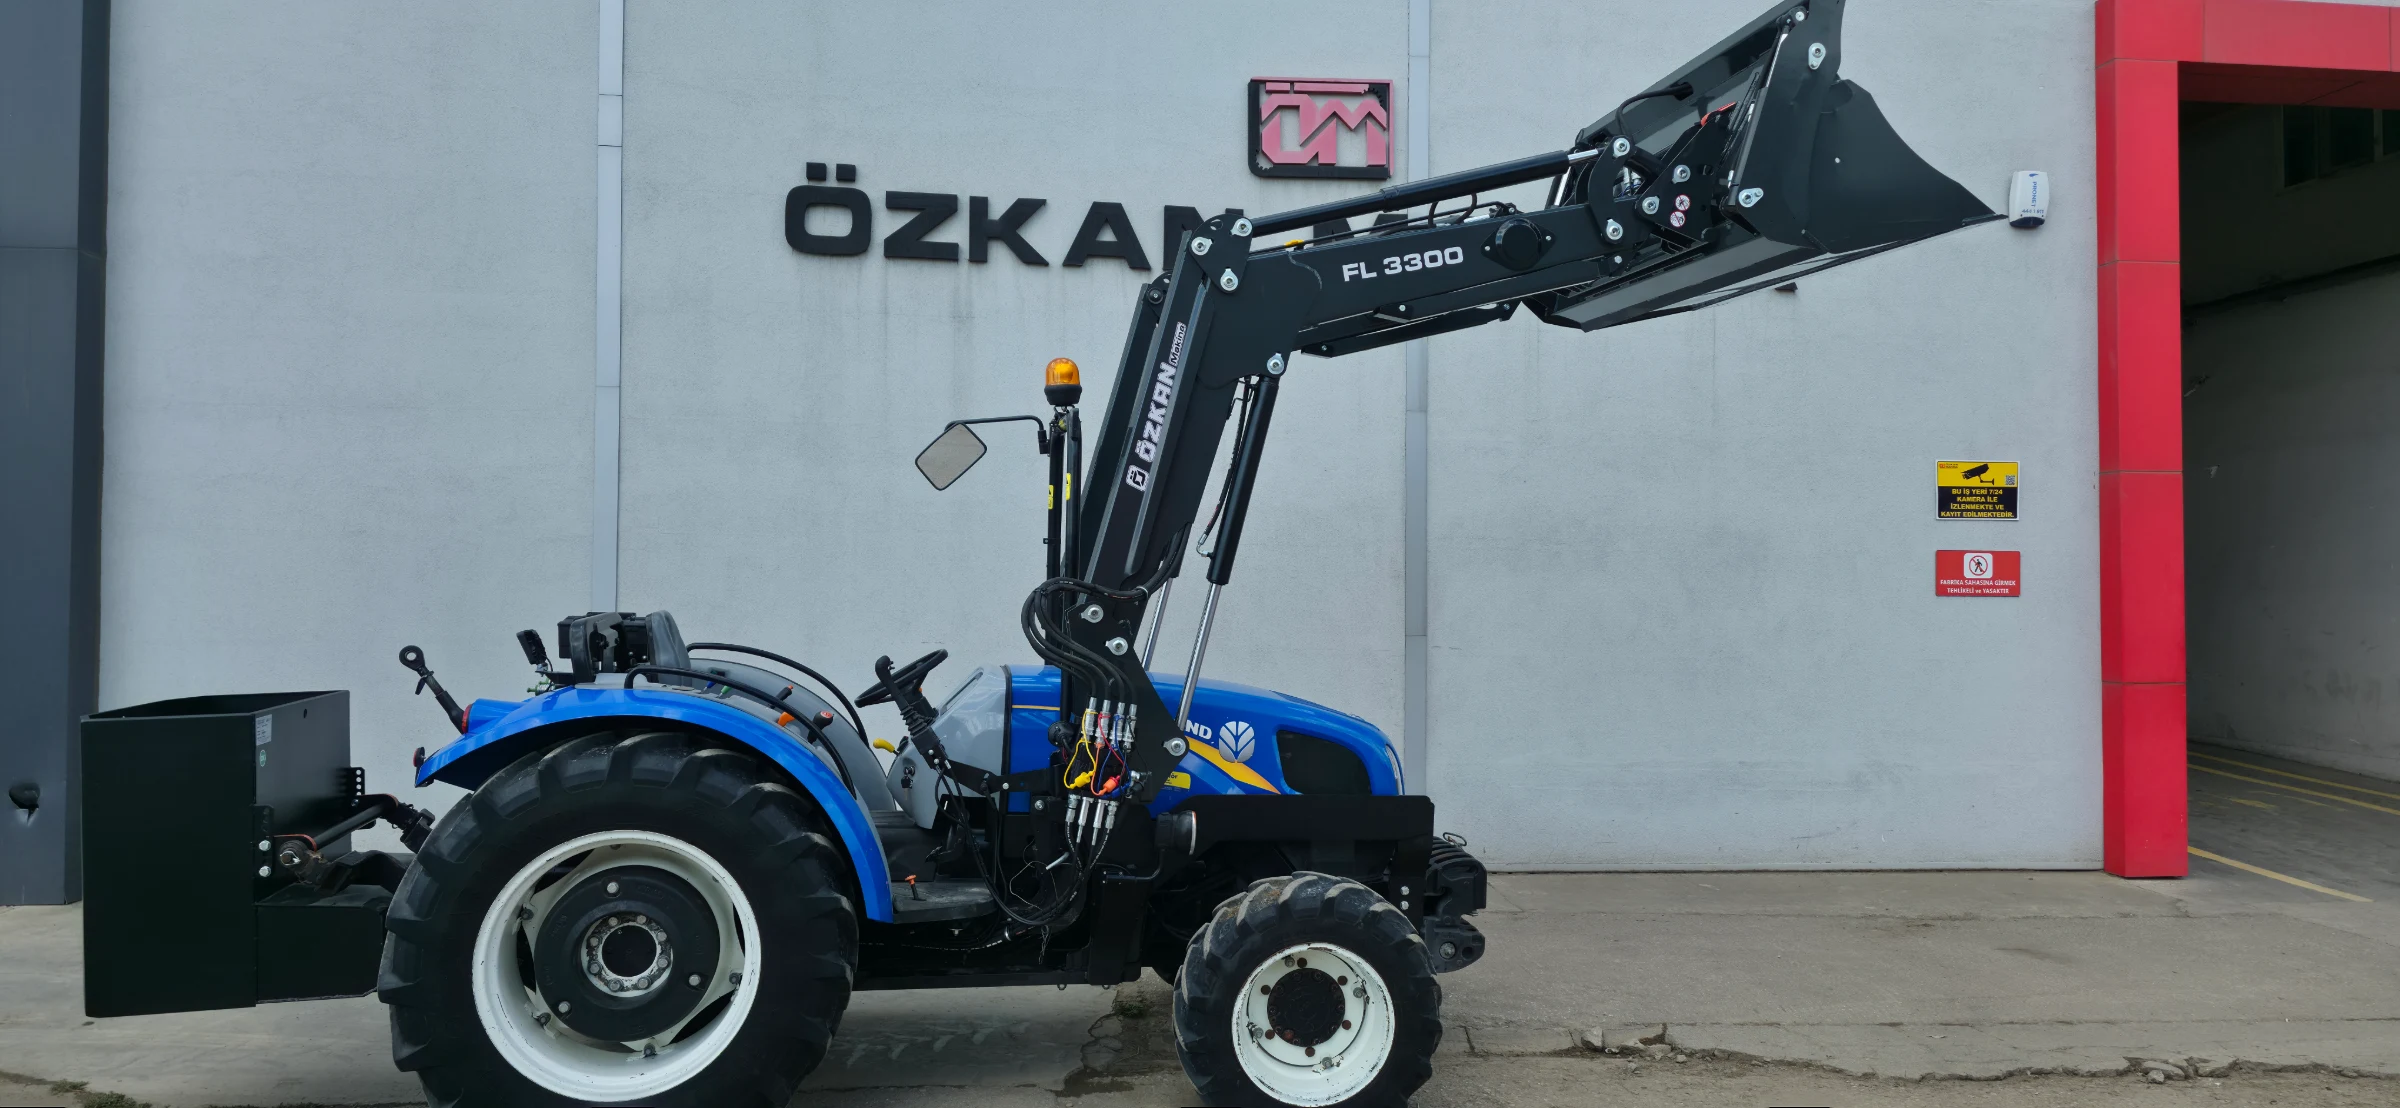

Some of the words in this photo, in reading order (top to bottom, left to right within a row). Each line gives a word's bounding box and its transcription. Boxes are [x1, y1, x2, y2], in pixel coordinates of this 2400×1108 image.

[1342, 261, 1377, 282] FL
[1383, 246, 1464, 275] 3300
[1135, 361, 1178, 463] ÖZKAN
[1170, 323, 1186, 365] Makina
[1185, 719, 1212, 740] ND
